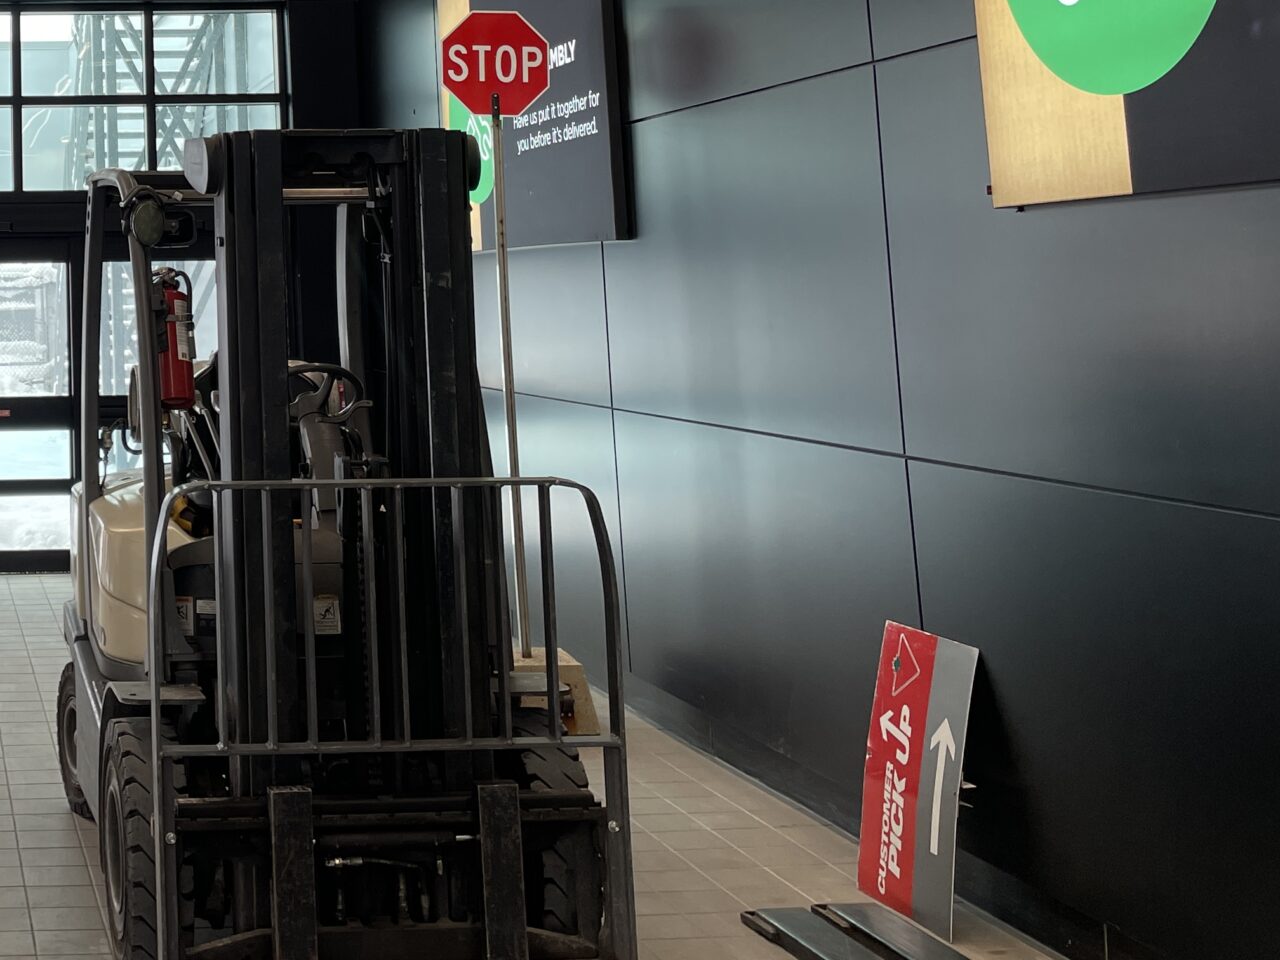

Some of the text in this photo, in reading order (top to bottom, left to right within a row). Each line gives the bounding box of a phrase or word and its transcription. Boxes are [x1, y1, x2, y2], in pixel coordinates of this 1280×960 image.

[448, 44, 543, 83] STOP
[548, 39, 576, 70] MBLY
[513, 89, 600, 130] Have us put it together for
[516, 115, 599, 156] you before it's delivered.
[877, 760, 894, 895] CUSTOMER
[887, 768, 907, 880] PICK
